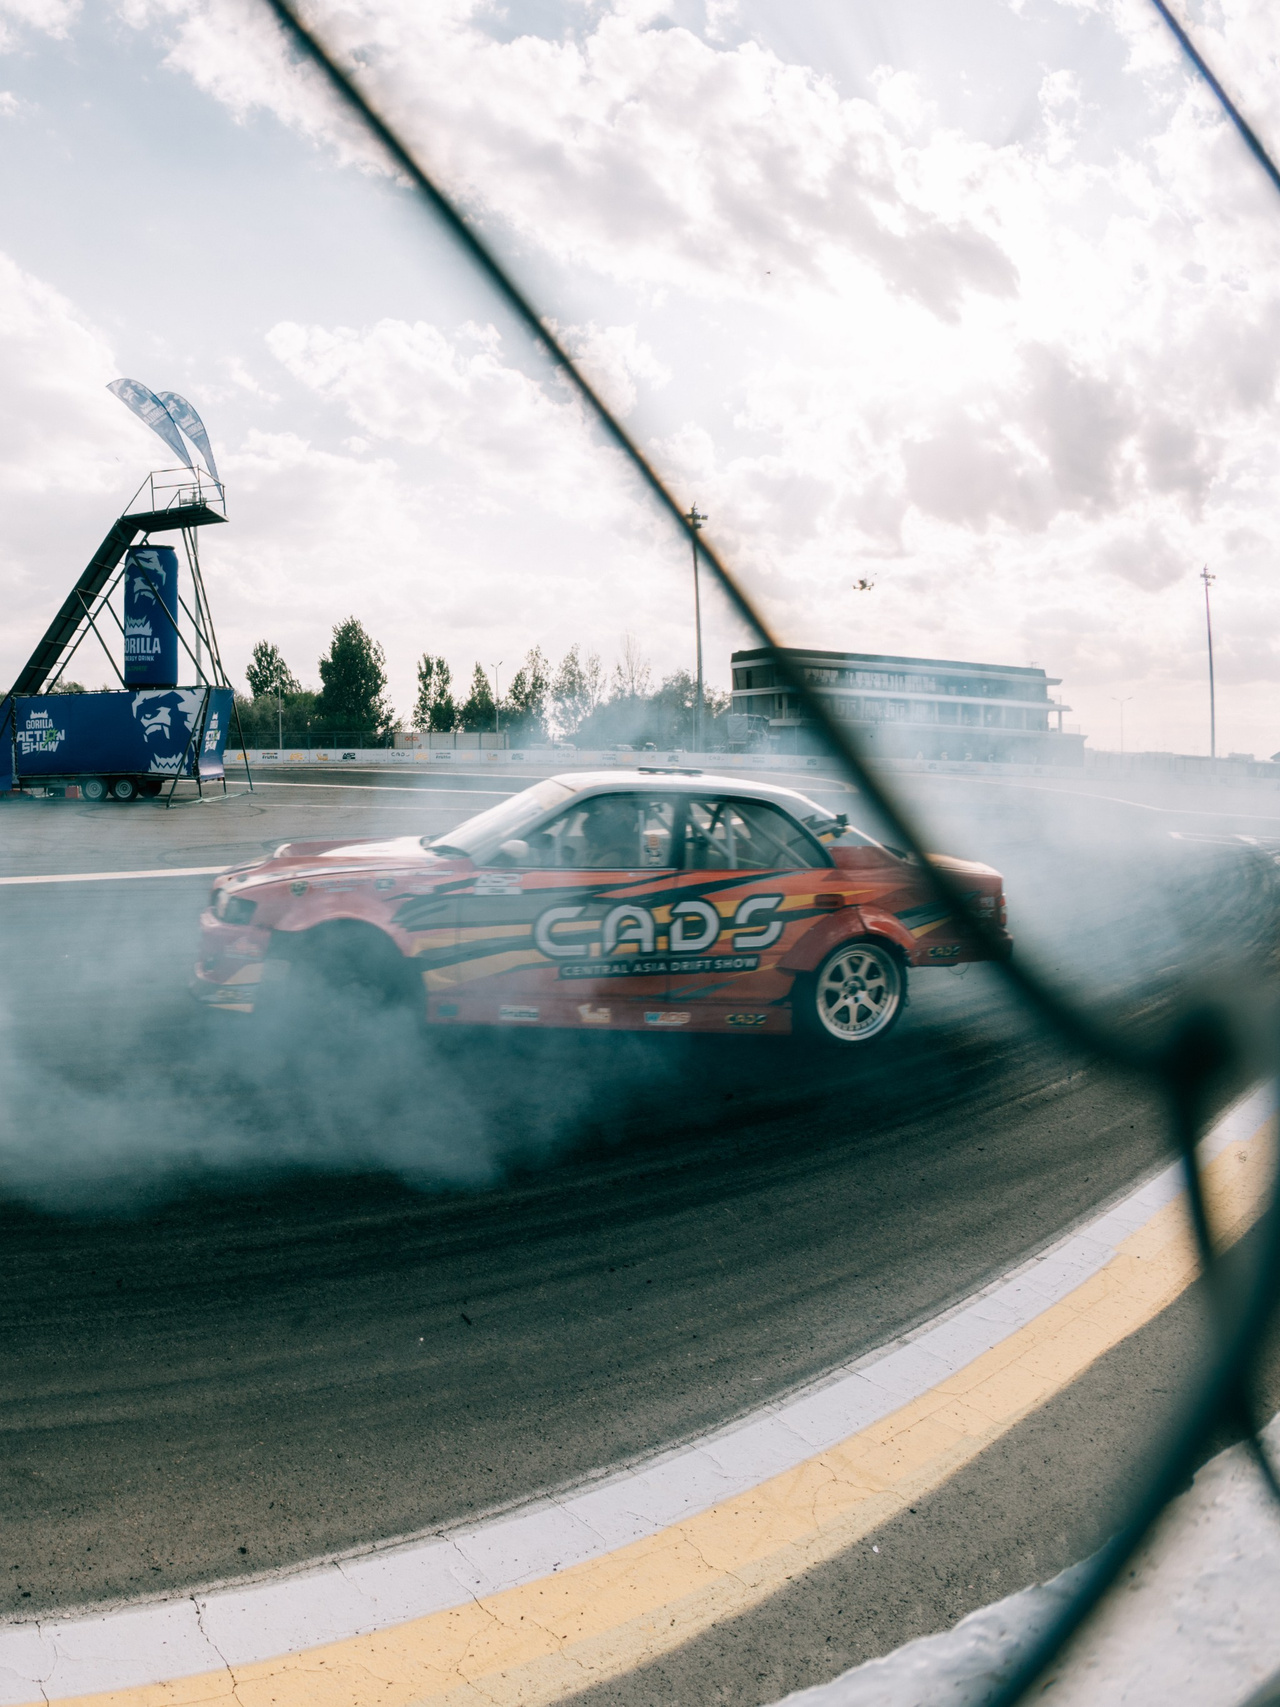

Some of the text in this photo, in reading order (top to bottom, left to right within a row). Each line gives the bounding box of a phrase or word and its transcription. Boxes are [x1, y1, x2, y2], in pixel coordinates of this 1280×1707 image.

[124, 637, 162, 654] ORILLA
[25, 718, 54, 730] GORILLA
[16, 729, 66, 743] ACTION
[21, 741, 59, 755] SHOW
[535, 896, 785, 958] CADS
[927, 945, 961, 957] CADS
[561, 956, 758, 977] CENTRAL ASIA DRIFT SHOW
[724, 1013, 768, 1025] CADS
